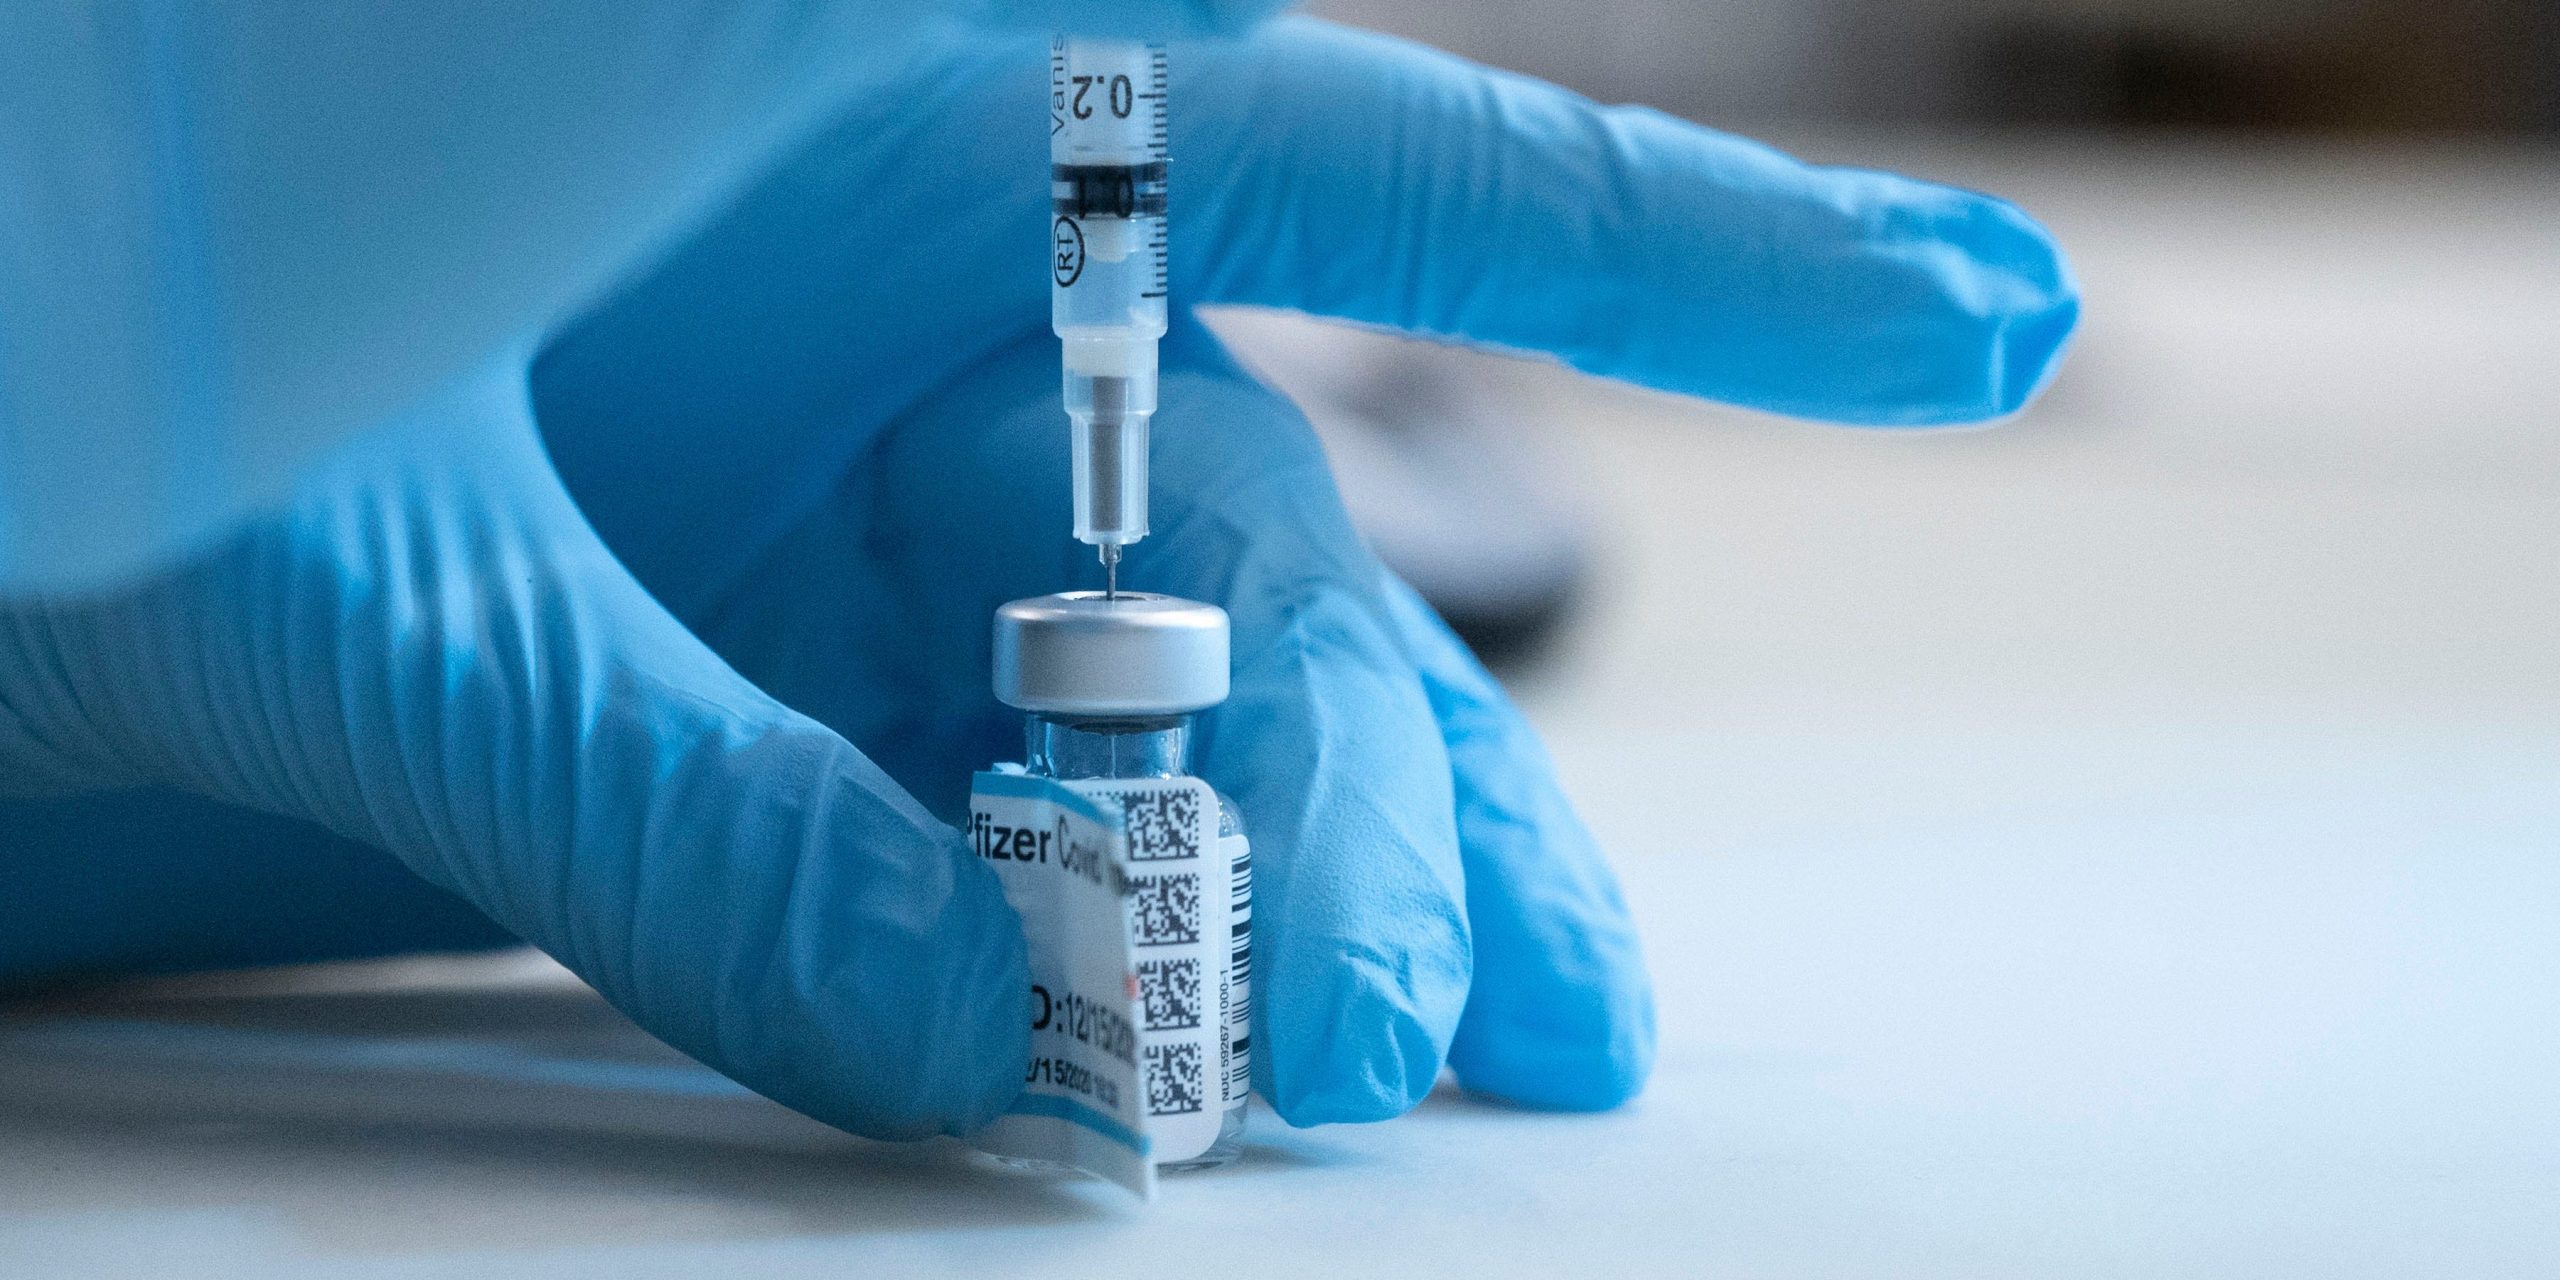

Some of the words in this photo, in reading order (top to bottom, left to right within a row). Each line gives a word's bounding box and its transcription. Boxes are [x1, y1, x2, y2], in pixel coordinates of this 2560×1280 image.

[1072, 74, 1133, 120] 0.2
[1057, 233, 1074, 272] RT
[1219, 969, 1230, 1069] 59267-1000-1
[1221, 1071, 1230, 1102] NDC
